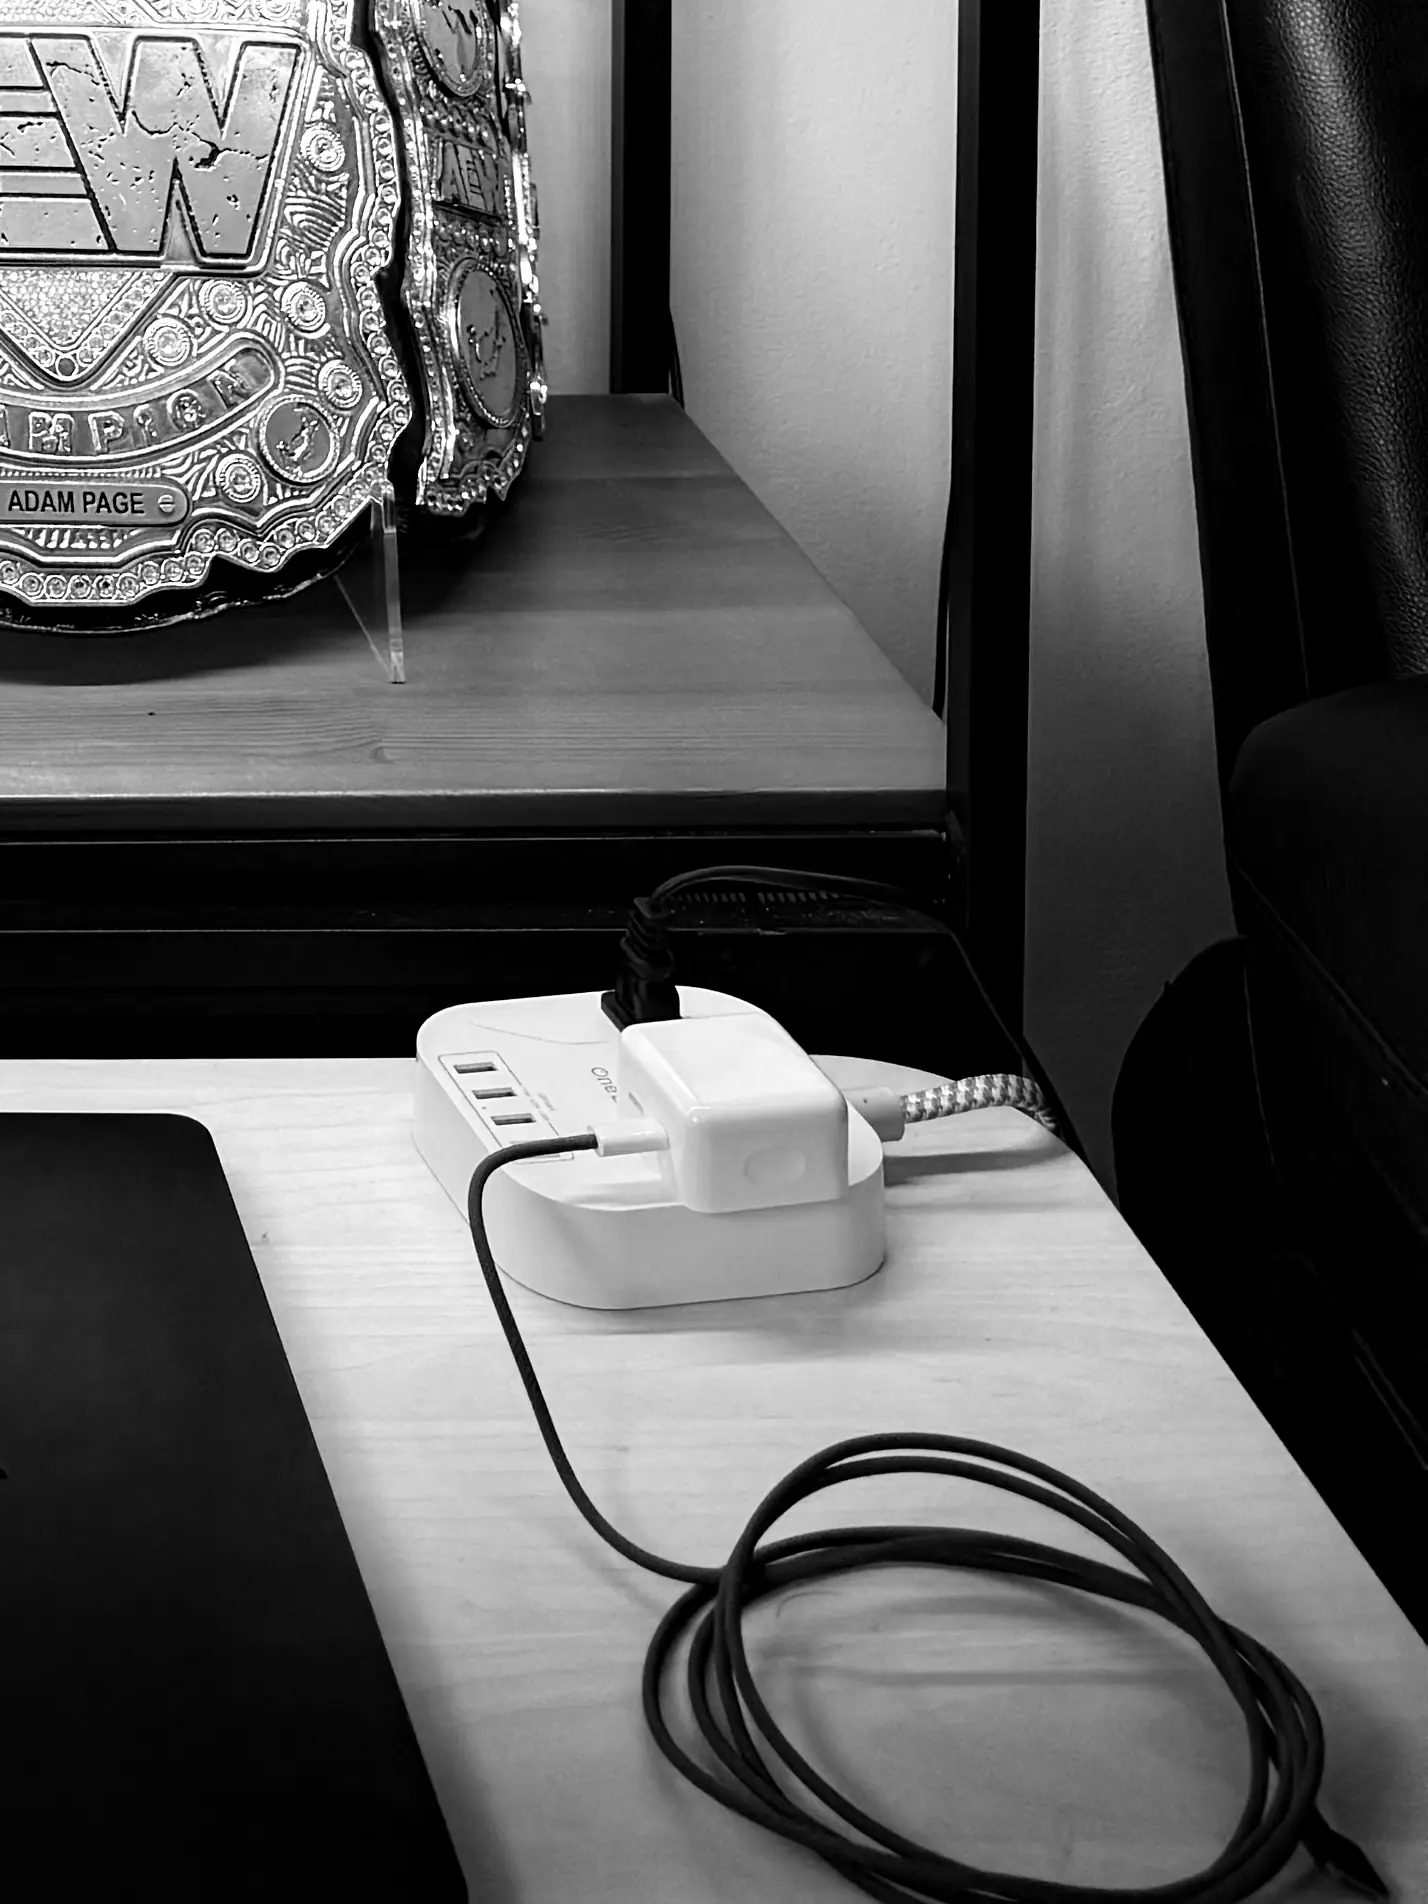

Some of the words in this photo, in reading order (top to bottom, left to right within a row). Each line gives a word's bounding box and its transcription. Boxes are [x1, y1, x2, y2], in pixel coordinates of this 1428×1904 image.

[7, 490, 76, 514] ADAM
[82, 491, 145, 515] PAGE
[590, 1066, 618, 1103] One
